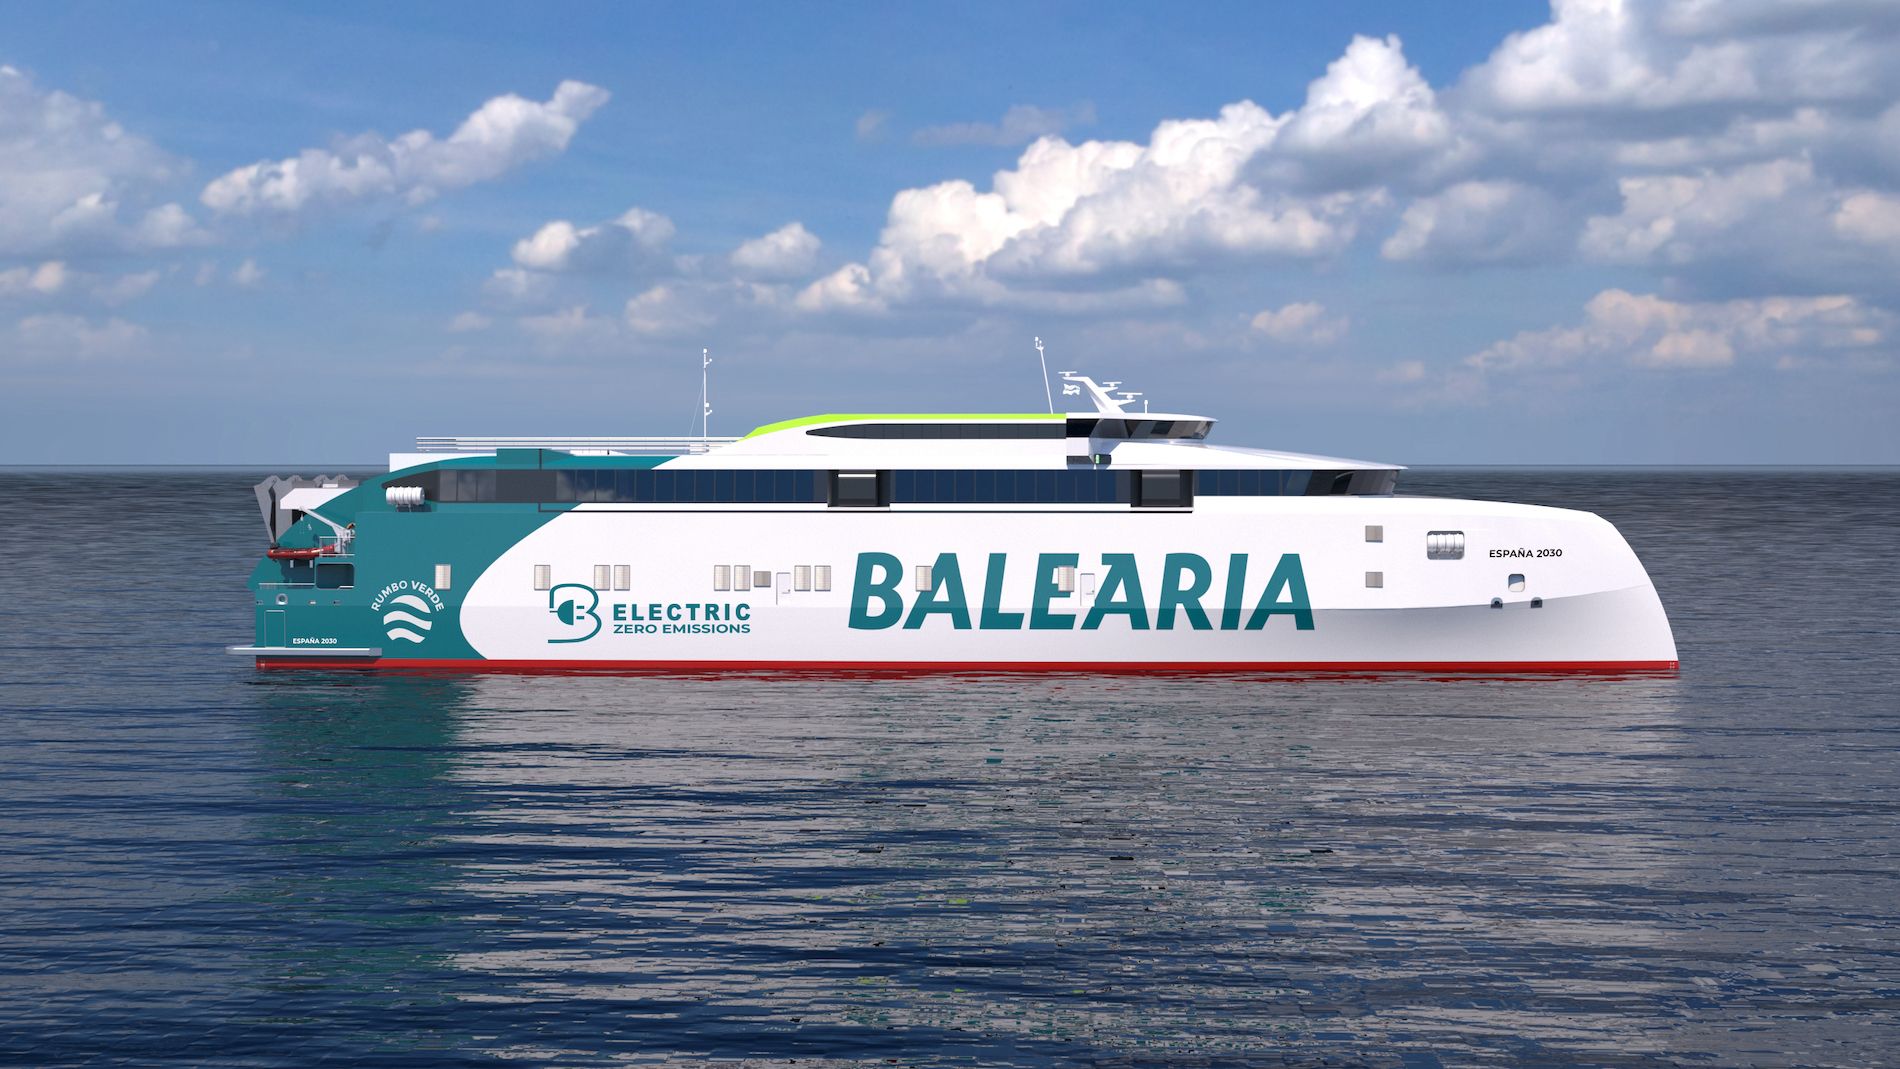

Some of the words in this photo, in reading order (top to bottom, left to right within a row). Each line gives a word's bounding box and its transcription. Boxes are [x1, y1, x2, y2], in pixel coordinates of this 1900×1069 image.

[1489, 547, 1534, 558] ESPAÑA
[1536, 548, 1563, 557] 2030
[371, 580, 408, 612] RUMBO
[411, 580, 445, 612] VERDE
[613, 603, 751, 621] ELECTRIC
[613, 624, 657, 634] ZERO
[662, 624, 751, 634] EMISSIONS
[292, 636, 320, 645] ESPAÑA
[320, 637, 338, 645] 2030
